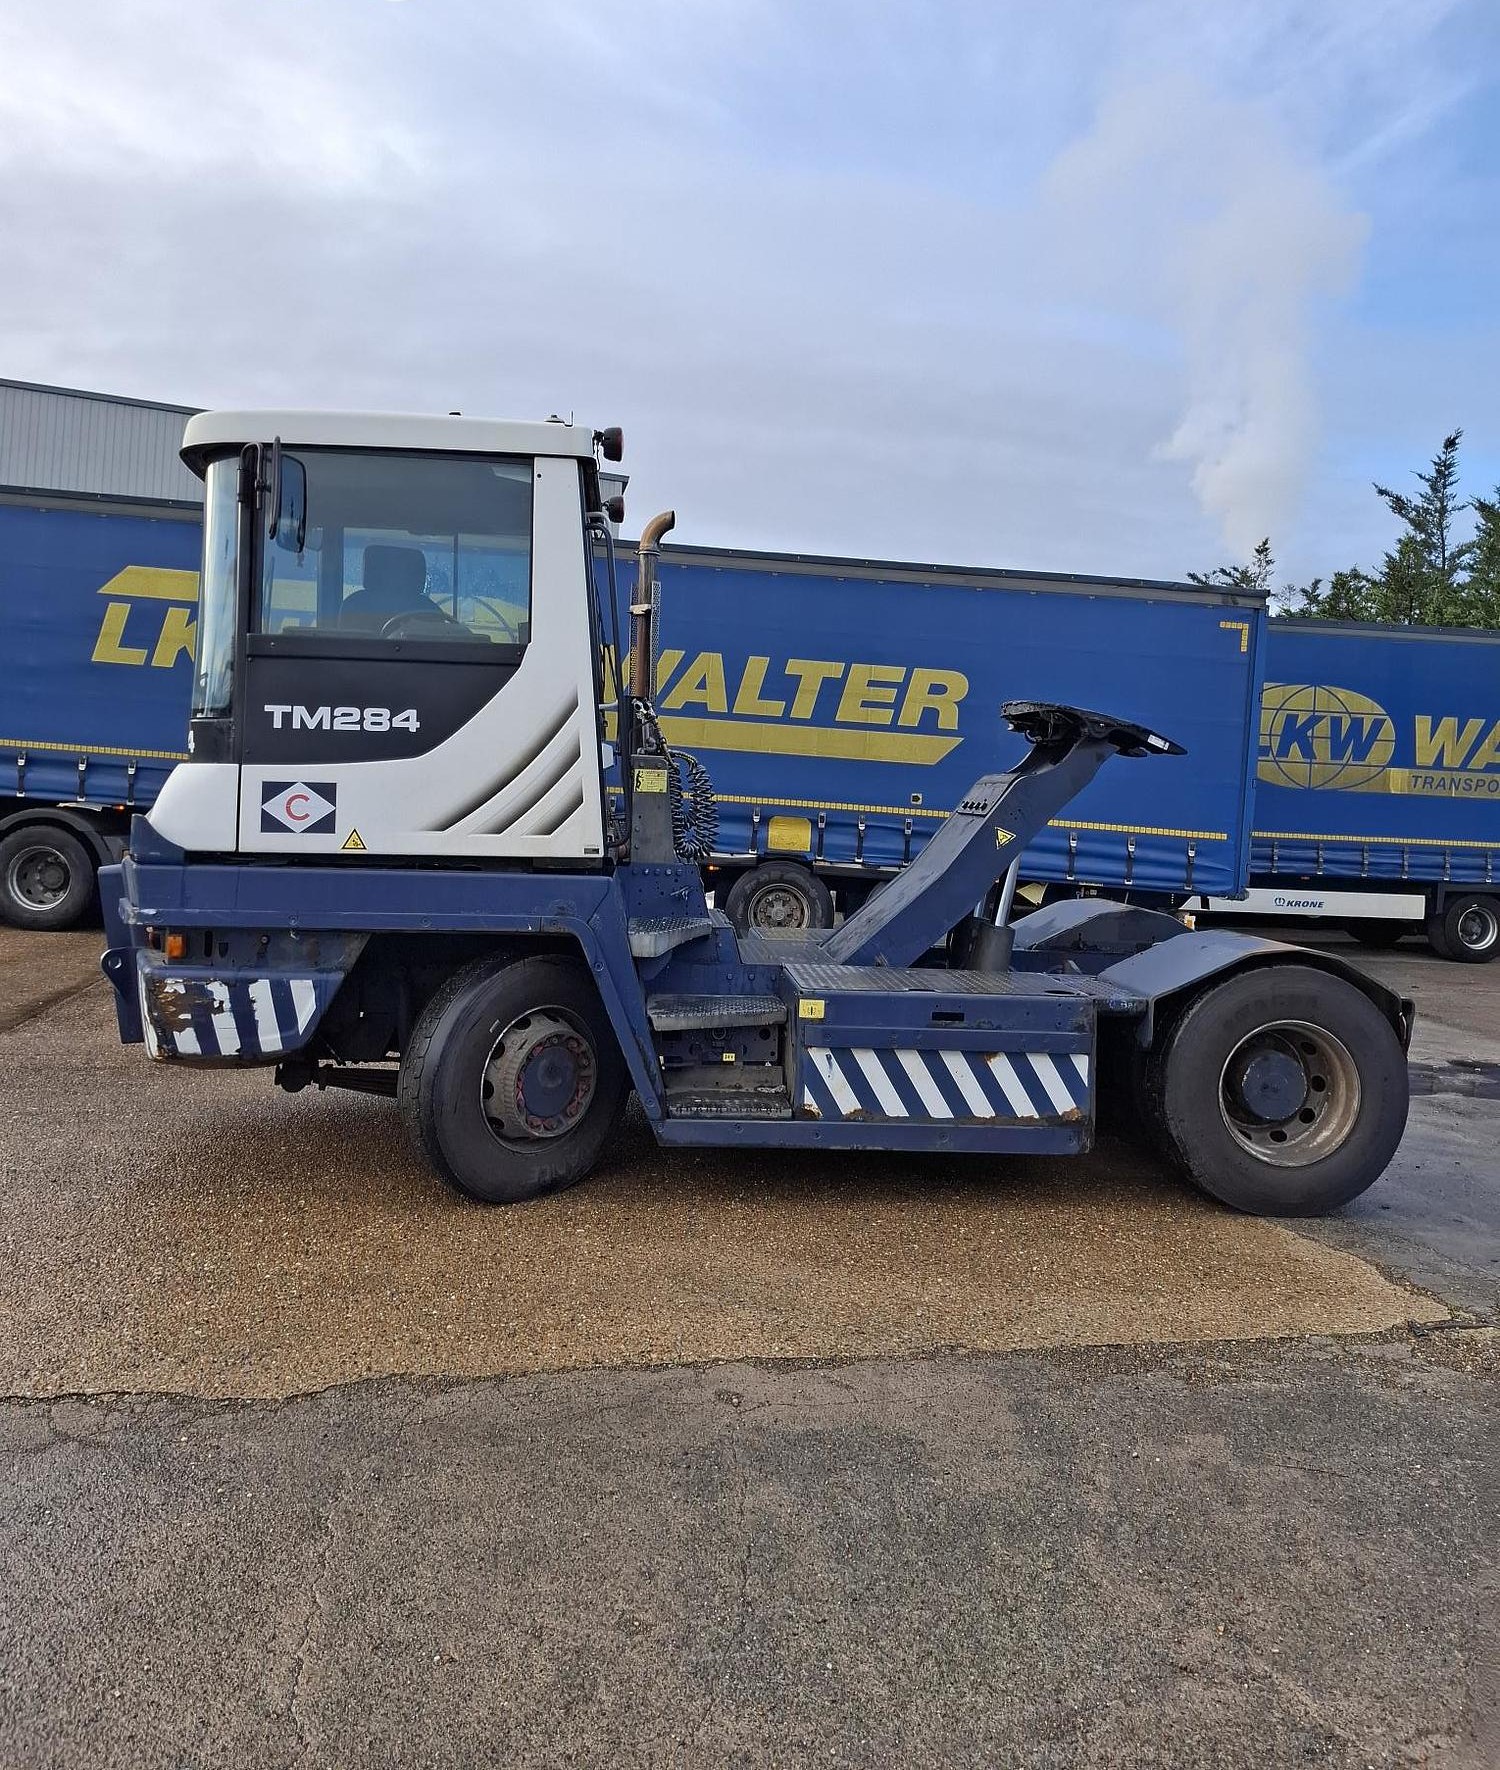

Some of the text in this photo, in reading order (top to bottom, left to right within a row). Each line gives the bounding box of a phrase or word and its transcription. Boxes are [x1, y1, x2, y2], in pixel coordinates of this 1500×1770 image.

[264, 704, 421, 733] TM284
[285, 794, 311, 822] C
[1286, 899, 1325, 909] KRONE
